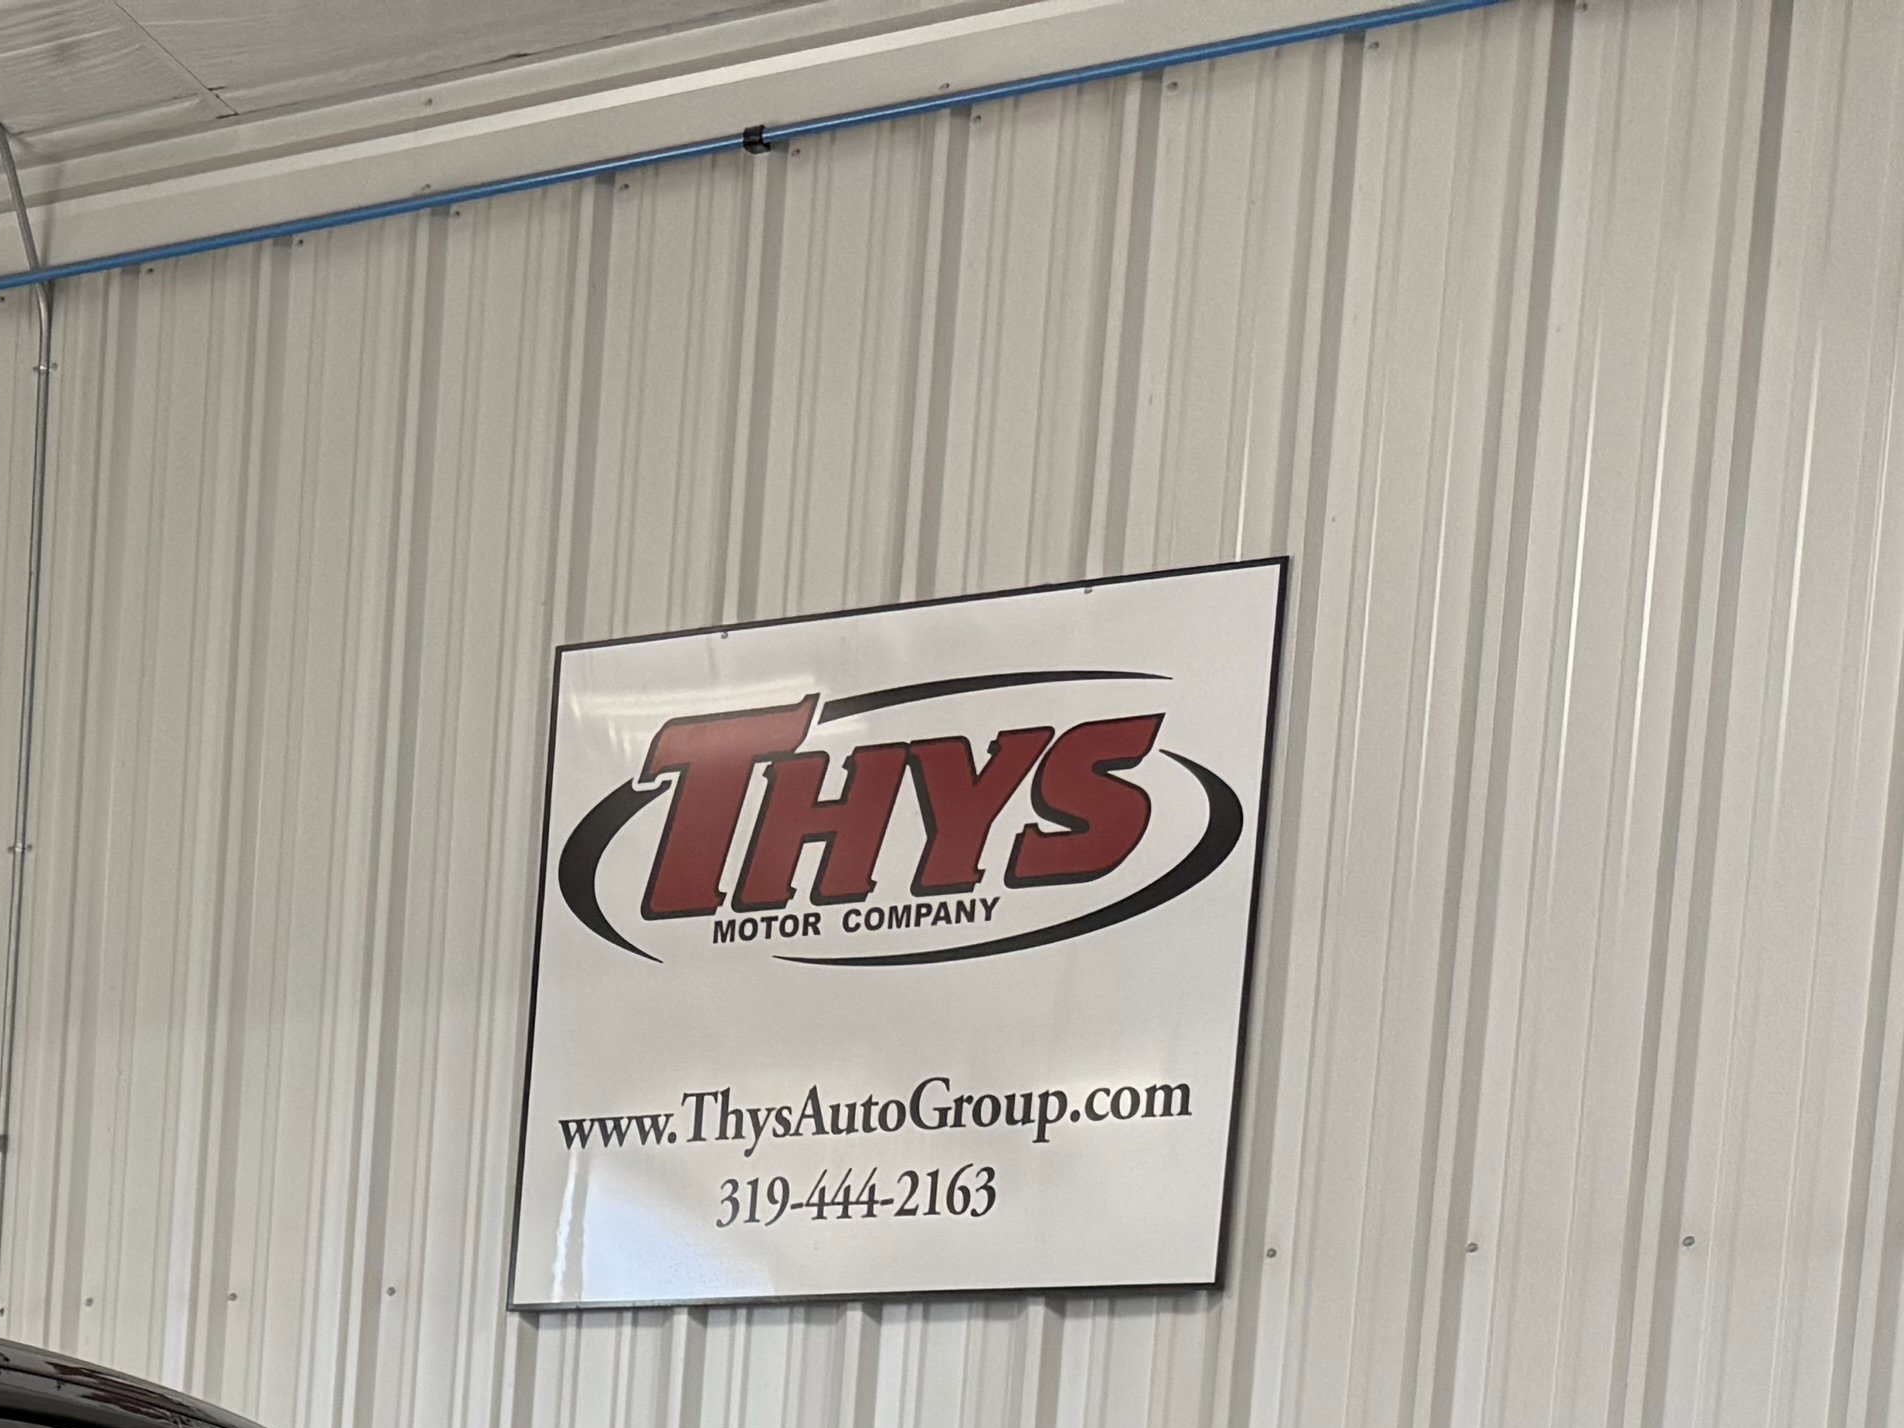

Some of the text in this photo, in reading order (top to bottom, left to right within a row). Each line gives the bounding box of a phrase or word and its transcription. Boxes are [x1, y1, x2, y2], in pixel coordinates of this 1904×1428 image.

[634, 692, 1167, 921] THYS
[712, 896, 1001, 944] MOTOR COMPANY
[558, 1076, 1193, 1158] www.ThysAutoGroup.com
[715, 1163, 997, 1228] 319-444-2163
